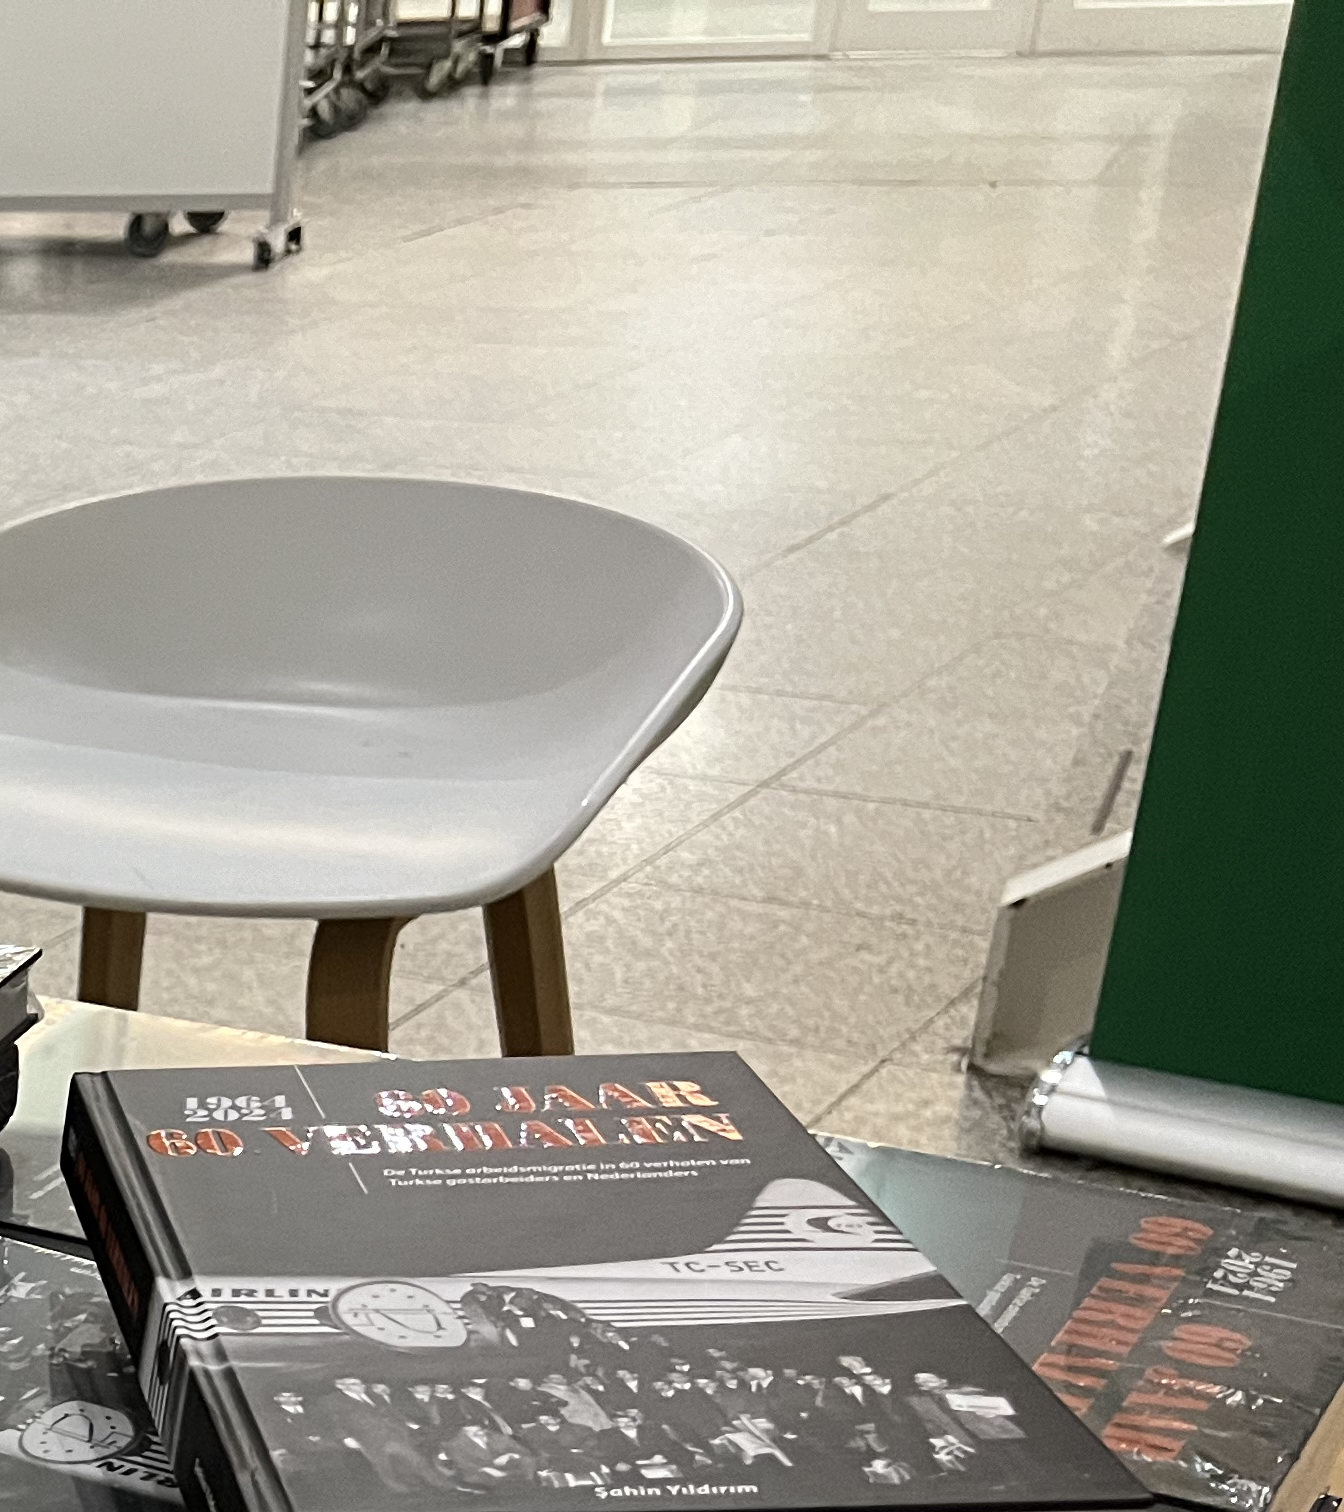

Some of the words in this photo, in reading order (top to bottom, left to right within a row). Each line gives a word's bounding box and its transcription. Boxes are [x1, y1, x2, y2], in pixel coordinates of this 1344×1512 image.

[185, 1094, 287, 1110] 1964
[493, 1081, 720, 1114] JAAR
[183, 1106, 294, 1123] 2024
[146, 1128, 244, 1158] 60
[260, 1113, 745, 1157] VERHALEN
[383, 1168, 405, 1177] De
[409, 1166, 461, 1177] Turkse
[465, 1162, 597, 1176] arbeidsmigratie
[599, 1161, 616, 1171] in
[618, 1160, 640, 1170] 60
[643, 1157, 717, 1169] verhalen
[719, 1157, 752, 1166] van
[389, 1177, 442, 1187] Turkse
[446, 1173, 560, 1187] gastarbeiders
[563, 1173, 583, 1182] en
[587, 1168, 699, 1181] Nederlanders
[1129, 1215, 1215, 1256] 60
[660, 1259, 786, 1274] TC-SEC
[1205, 1247, 1264, 1297] 2024
[1241, 1255, 1298, 1303] 1964
[1162, 1322, 1253, 1368] 60
[593, 1486, 662, 1500] Şahin
[665, 1484, 759, 1497] Yıldırım
